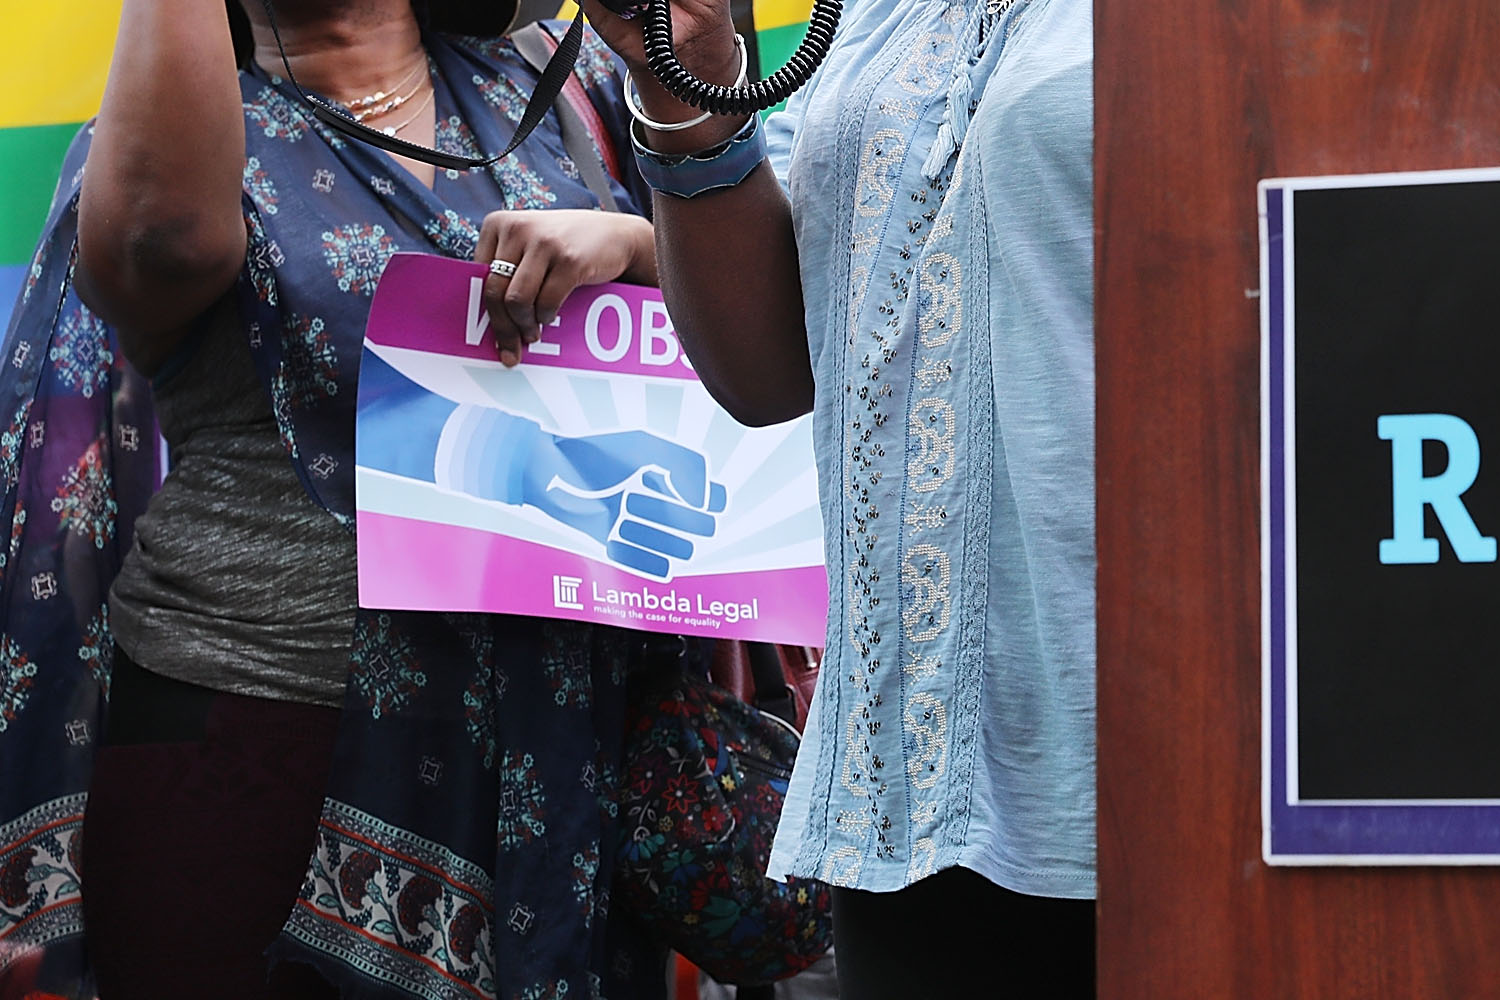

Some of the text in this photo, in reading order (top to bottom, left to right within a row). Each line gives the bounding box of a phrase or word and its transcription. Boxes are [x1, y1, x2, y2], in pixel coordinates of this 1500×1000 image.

[584, 293, 694, 372] OB
[591, 580, 759, 623] Lambda Legal
[593, 604, 721, 630] making the case for equality
